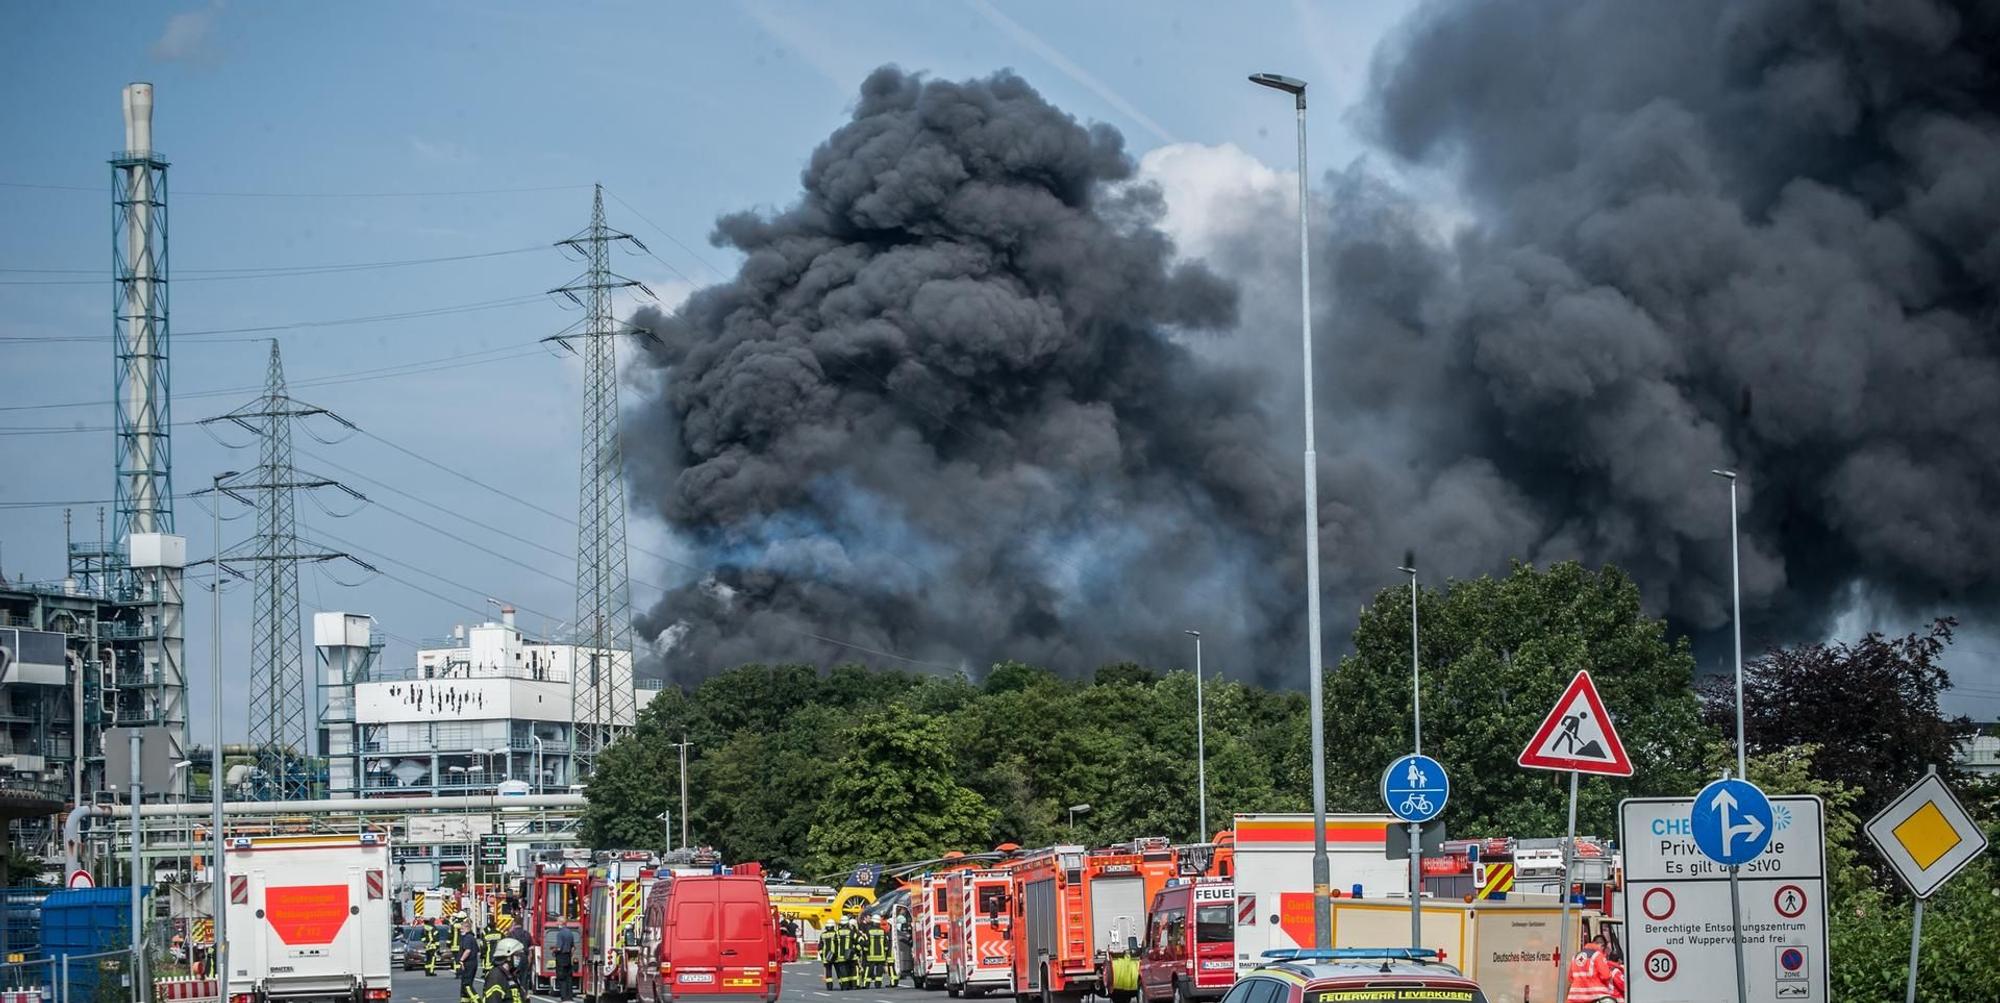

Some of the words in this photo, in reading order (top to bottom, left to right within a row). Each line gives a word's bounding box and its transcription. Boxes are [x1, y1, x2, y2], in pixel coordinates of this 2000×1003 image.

[1651, 818, 1691, 836] CHE
[1666, 860, 1683, 873] Es
[1690, 860, 1712, 876] gilt
[1748, 859, 1781, 872] StVO
[1645, 923, 1701, 934] Berechtigte
[1705, 922, 1806, 933] Entsoungszentrum
[1666, 935, 1684, 945] und
[1688, 935, 1765, 946] Wupperveband
[1769, 935, 1786, 943] frei
[1493, 951, 1519, 962] Deutsches
[1521, 951, 1536, 961] Rotes
[1536, 951, 1552, 961] Kreuz
[1651, 957, 1670, 973] 30
[1319, 991, 1396, 1003] FEUERWEHR
[1398, 991, 1473, 1002] LEVERKUSEN
